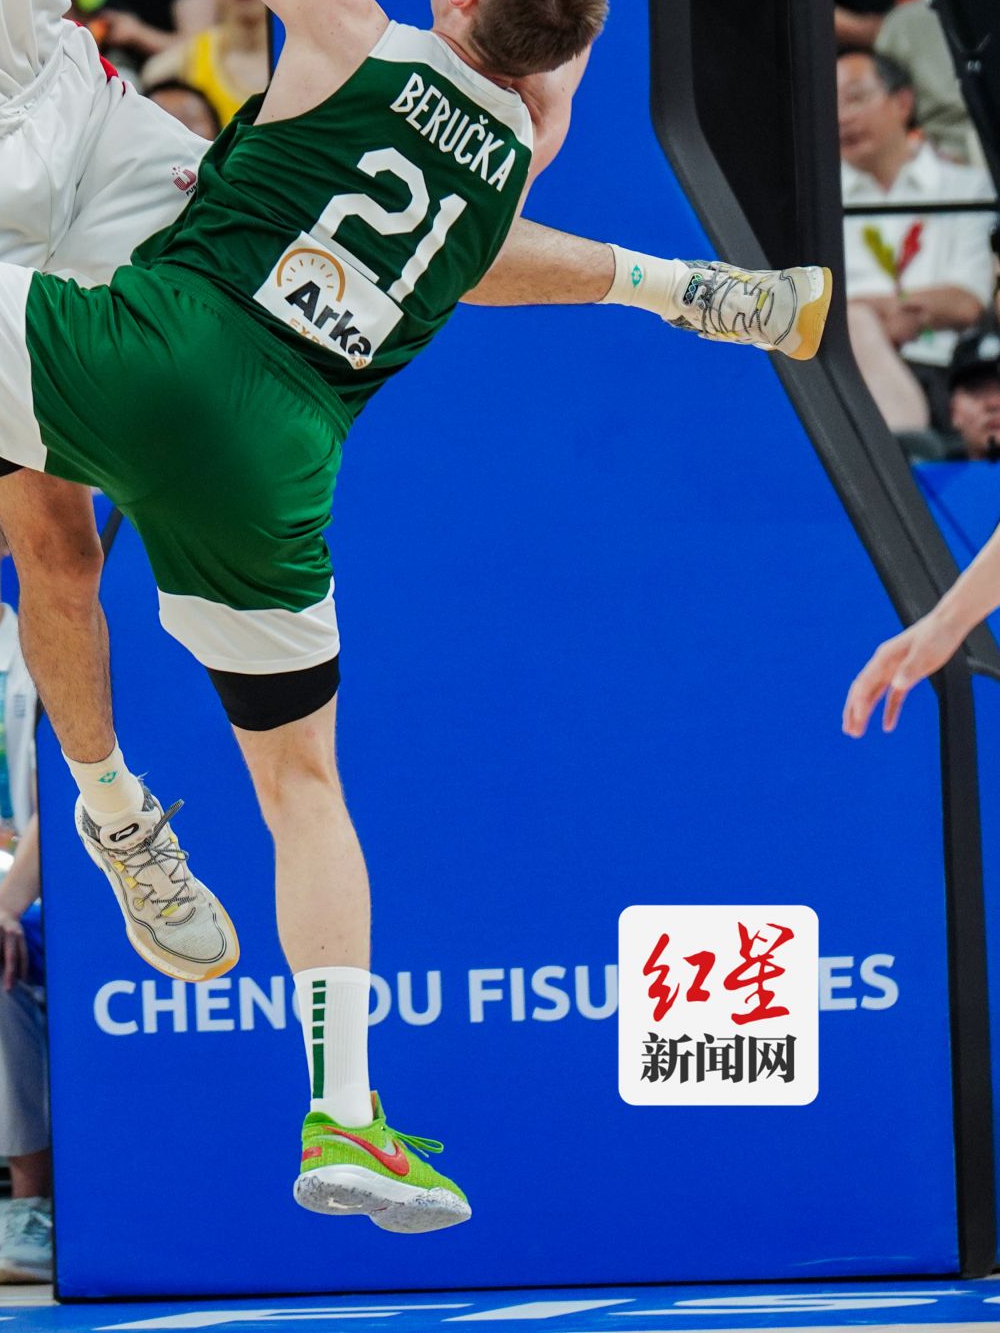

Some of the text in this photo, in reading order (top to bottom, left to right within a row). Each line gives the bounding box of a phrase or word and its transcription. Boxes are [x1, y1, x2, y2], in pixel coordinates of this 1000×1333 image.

[390, 72, 517, 193] BERUČKA
[308, 147, 468, 303] 21
[284, 280, 372, 359] Arka
[92, 1289, 1000, 1331] FIS
